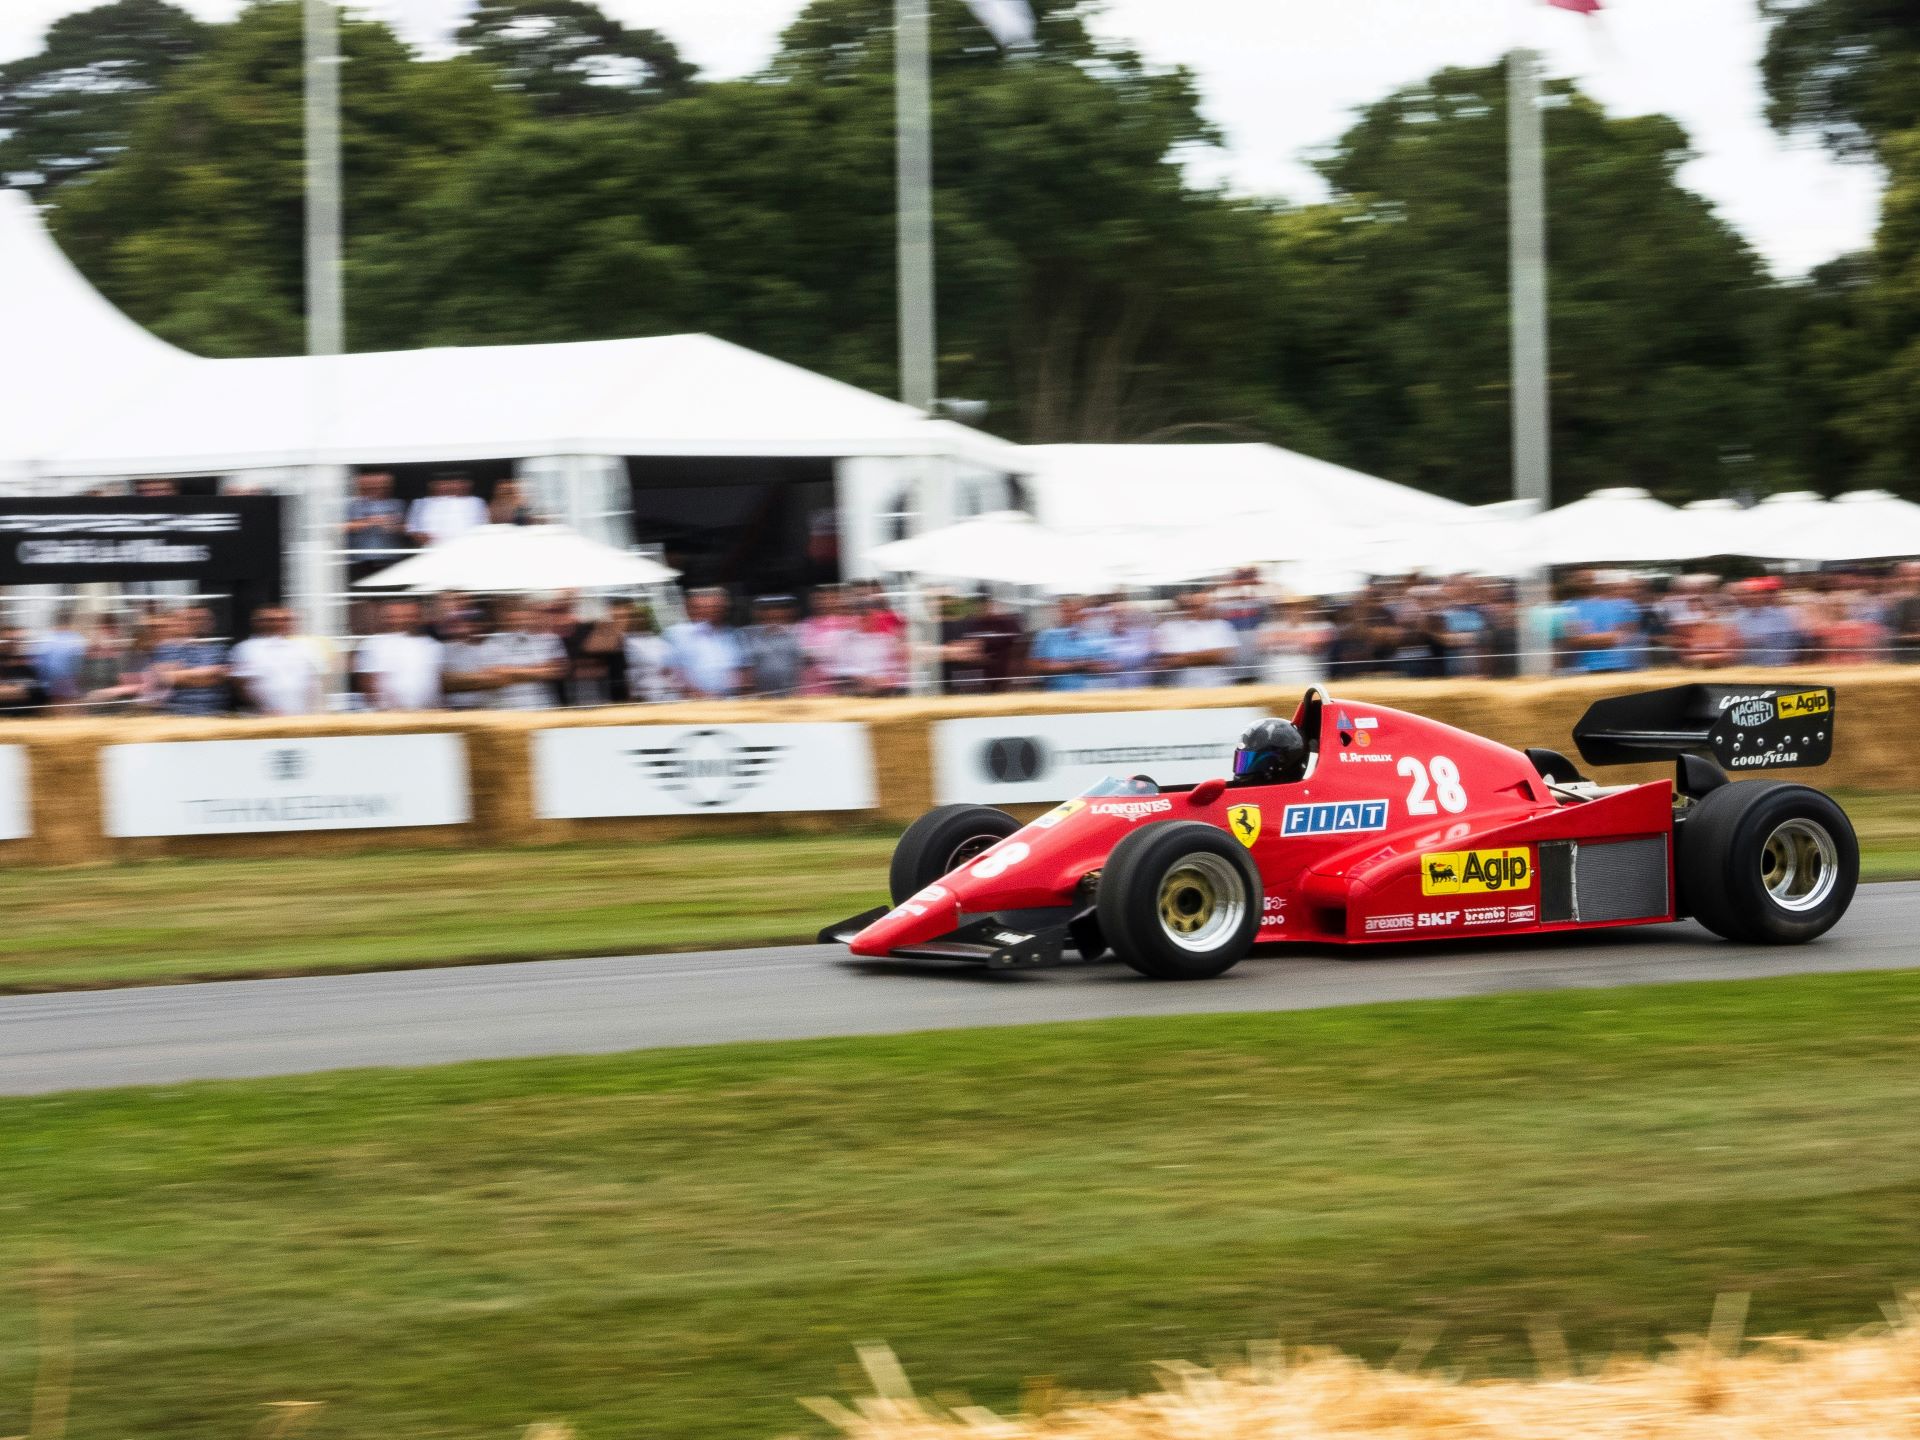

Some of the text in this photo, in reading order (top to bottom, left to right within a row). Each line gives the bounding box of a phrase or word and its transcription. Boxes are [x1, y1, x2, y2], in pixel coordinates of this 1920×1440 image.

[1796, 693, 1826, 712] Agip
[1731, 751, 1798, 766] GOODYEAR
[1396, 756, 1468, 816] 28
[1090, 799, 1172, 815] LONGINES
[1291, 806, 1381, 830] FIAT
[1462, 851, 1527, 890] Agip
[1365, 916, 1414, 930] arexons
[1417, 911, 1460, 927] SKF
[1465, 911, 1505, 921] brembo
